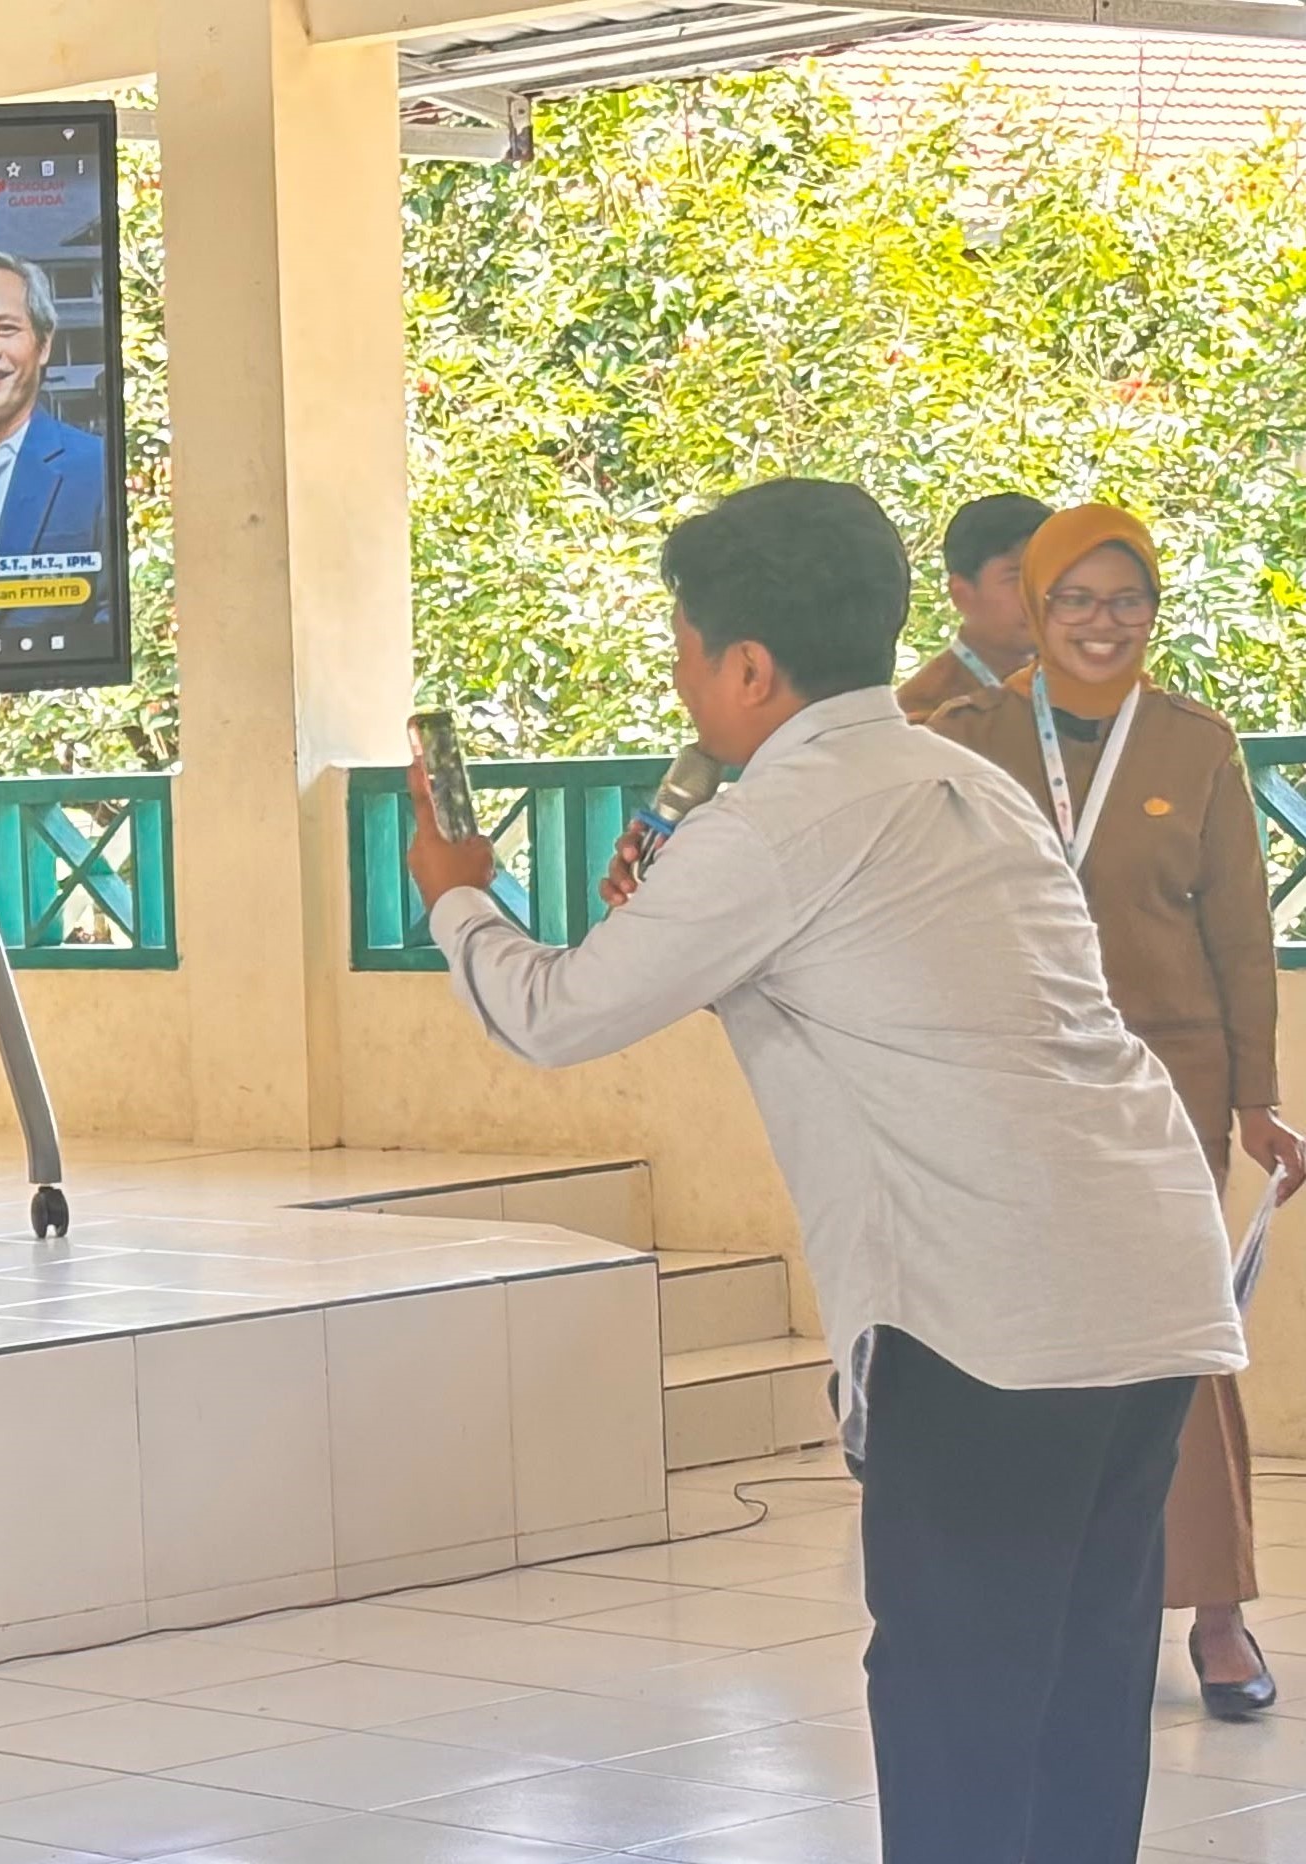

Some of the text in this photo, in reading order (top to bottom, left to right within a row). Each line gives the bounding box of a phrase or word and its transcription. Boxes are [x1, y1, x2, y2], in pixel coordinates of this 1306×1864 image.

[8, 196, 65, 207] GARUDA
[20, 587, 56, 600] FTTM
[59, 586, 80, 598] ITB
